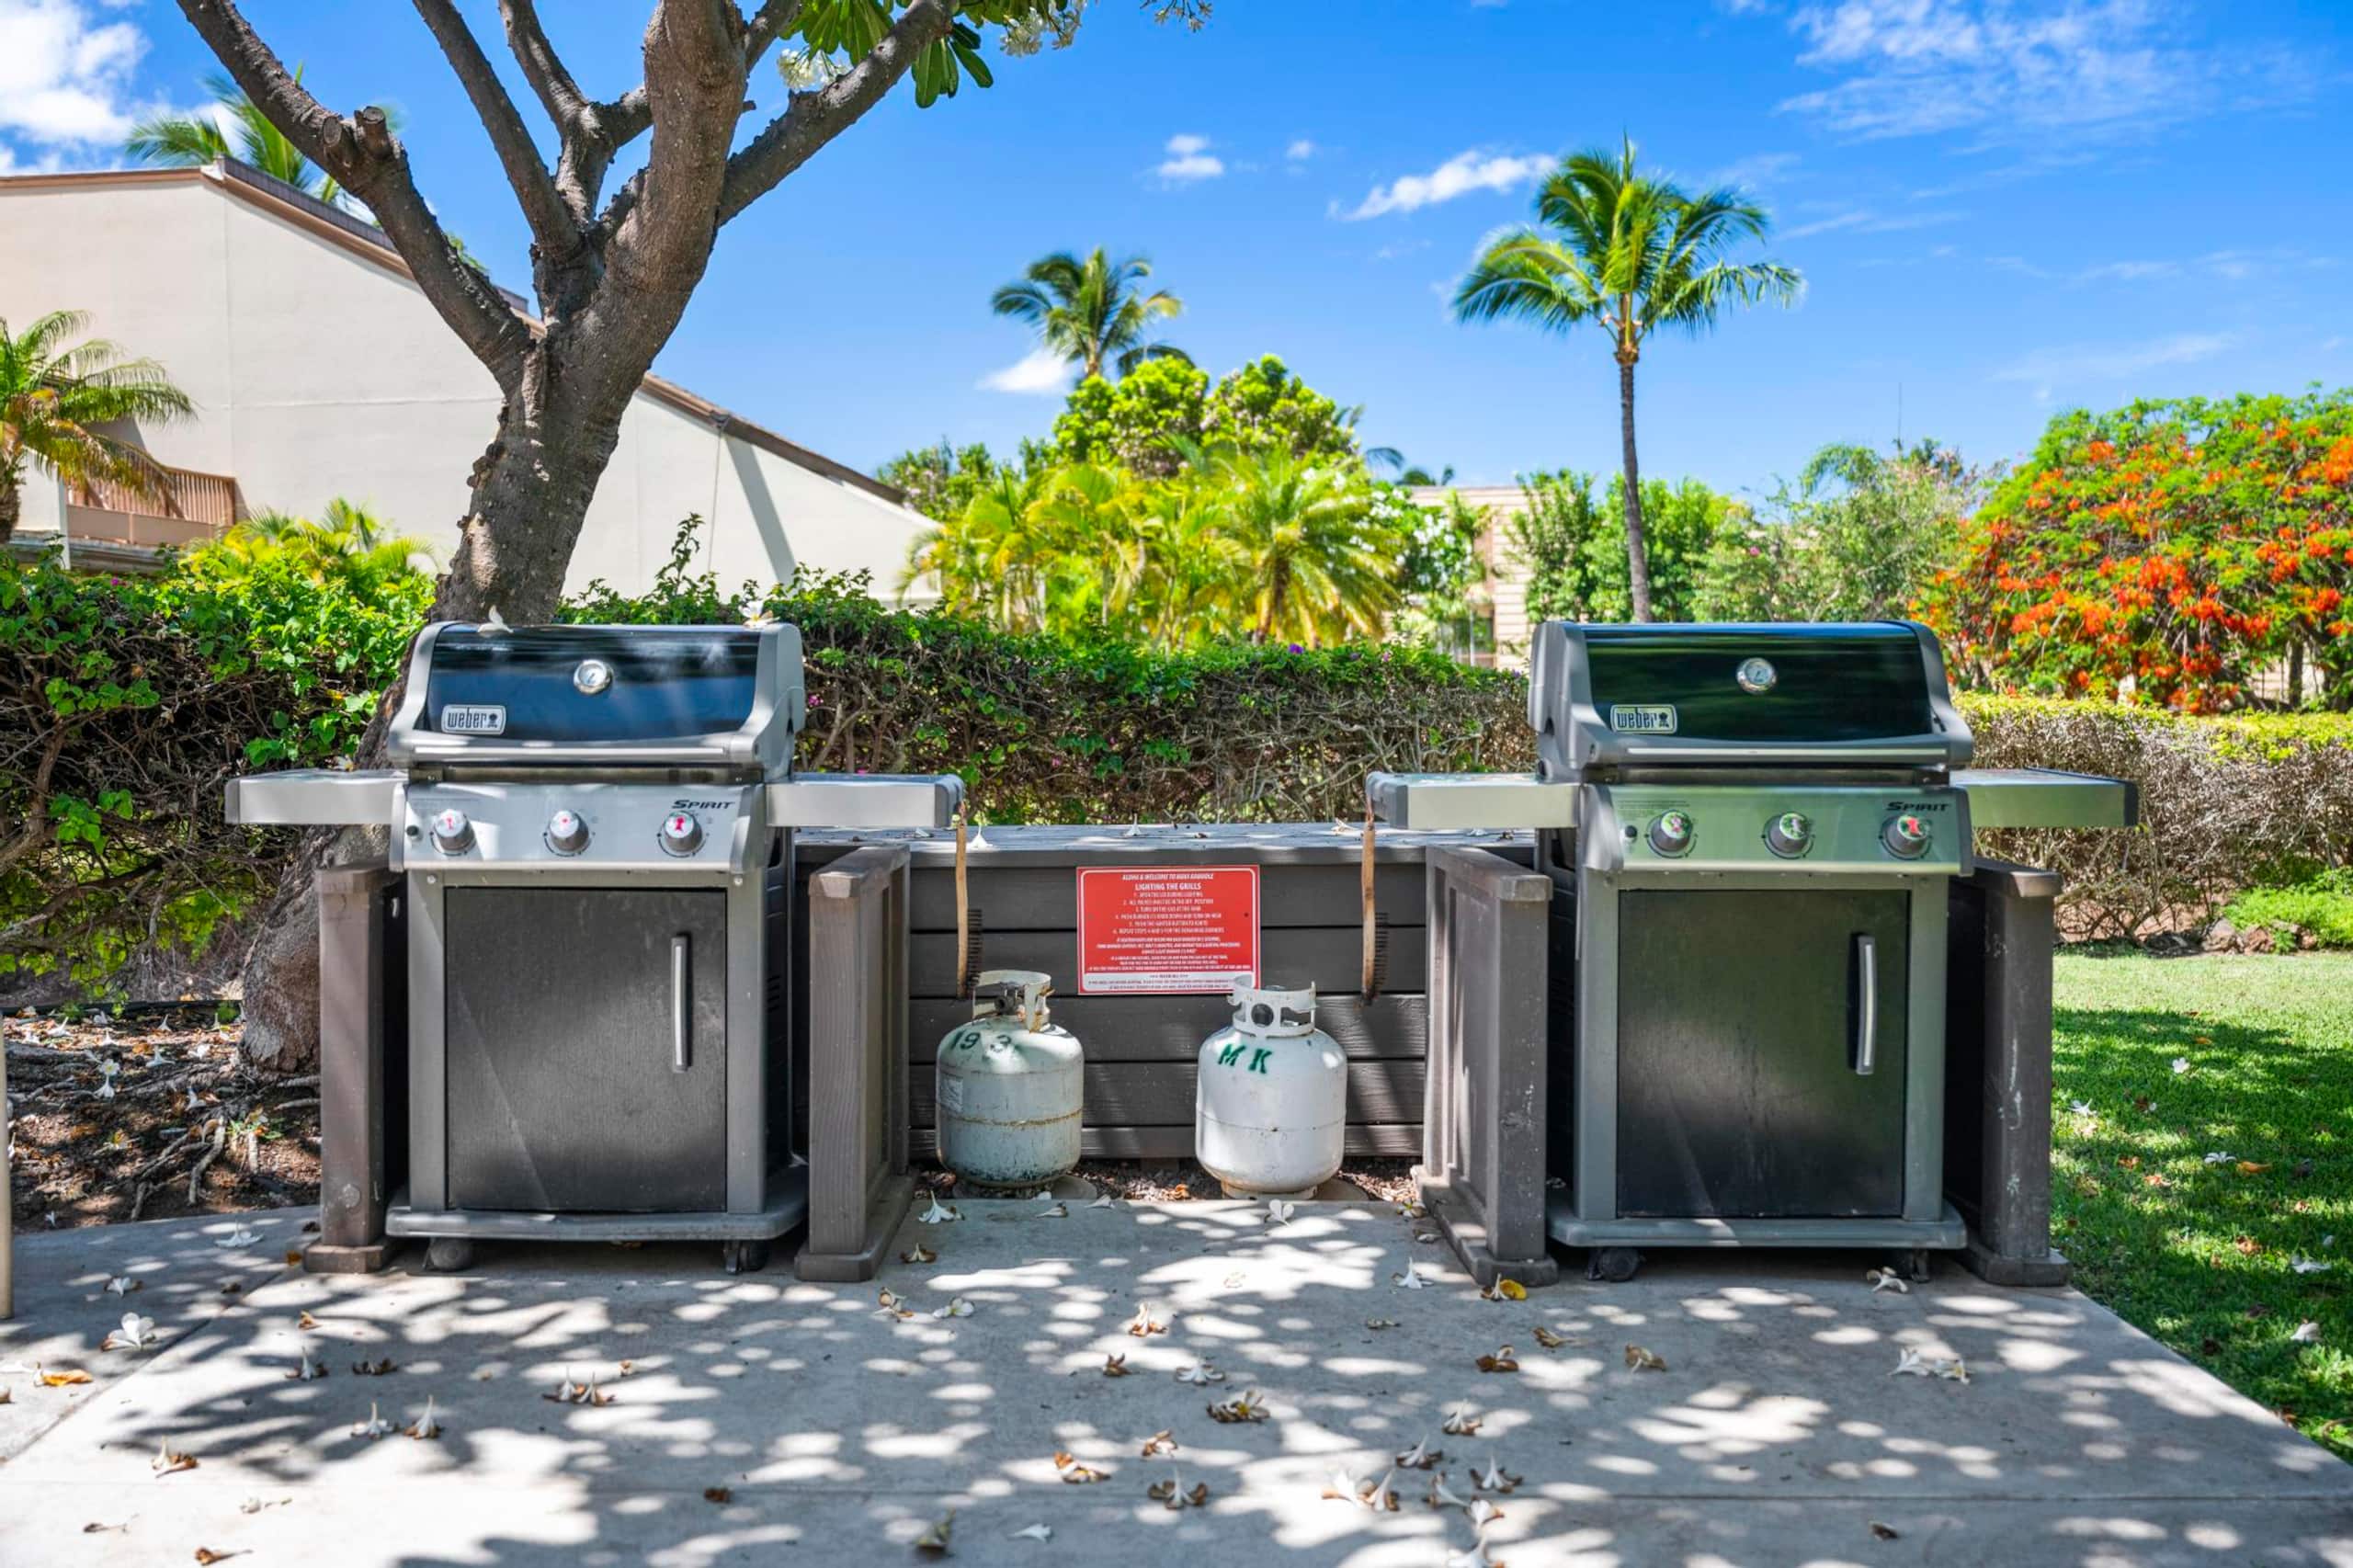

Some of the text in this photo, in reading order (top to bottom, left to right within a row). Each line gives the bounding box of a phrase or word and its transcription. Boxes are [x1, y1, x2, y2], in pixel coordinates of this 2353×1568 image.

[448, 707, 487, 728] weber
[1617, 707, 1657, 728] weber
[1134, 882, 1202, 891] LIGHTING THE GRILLS
